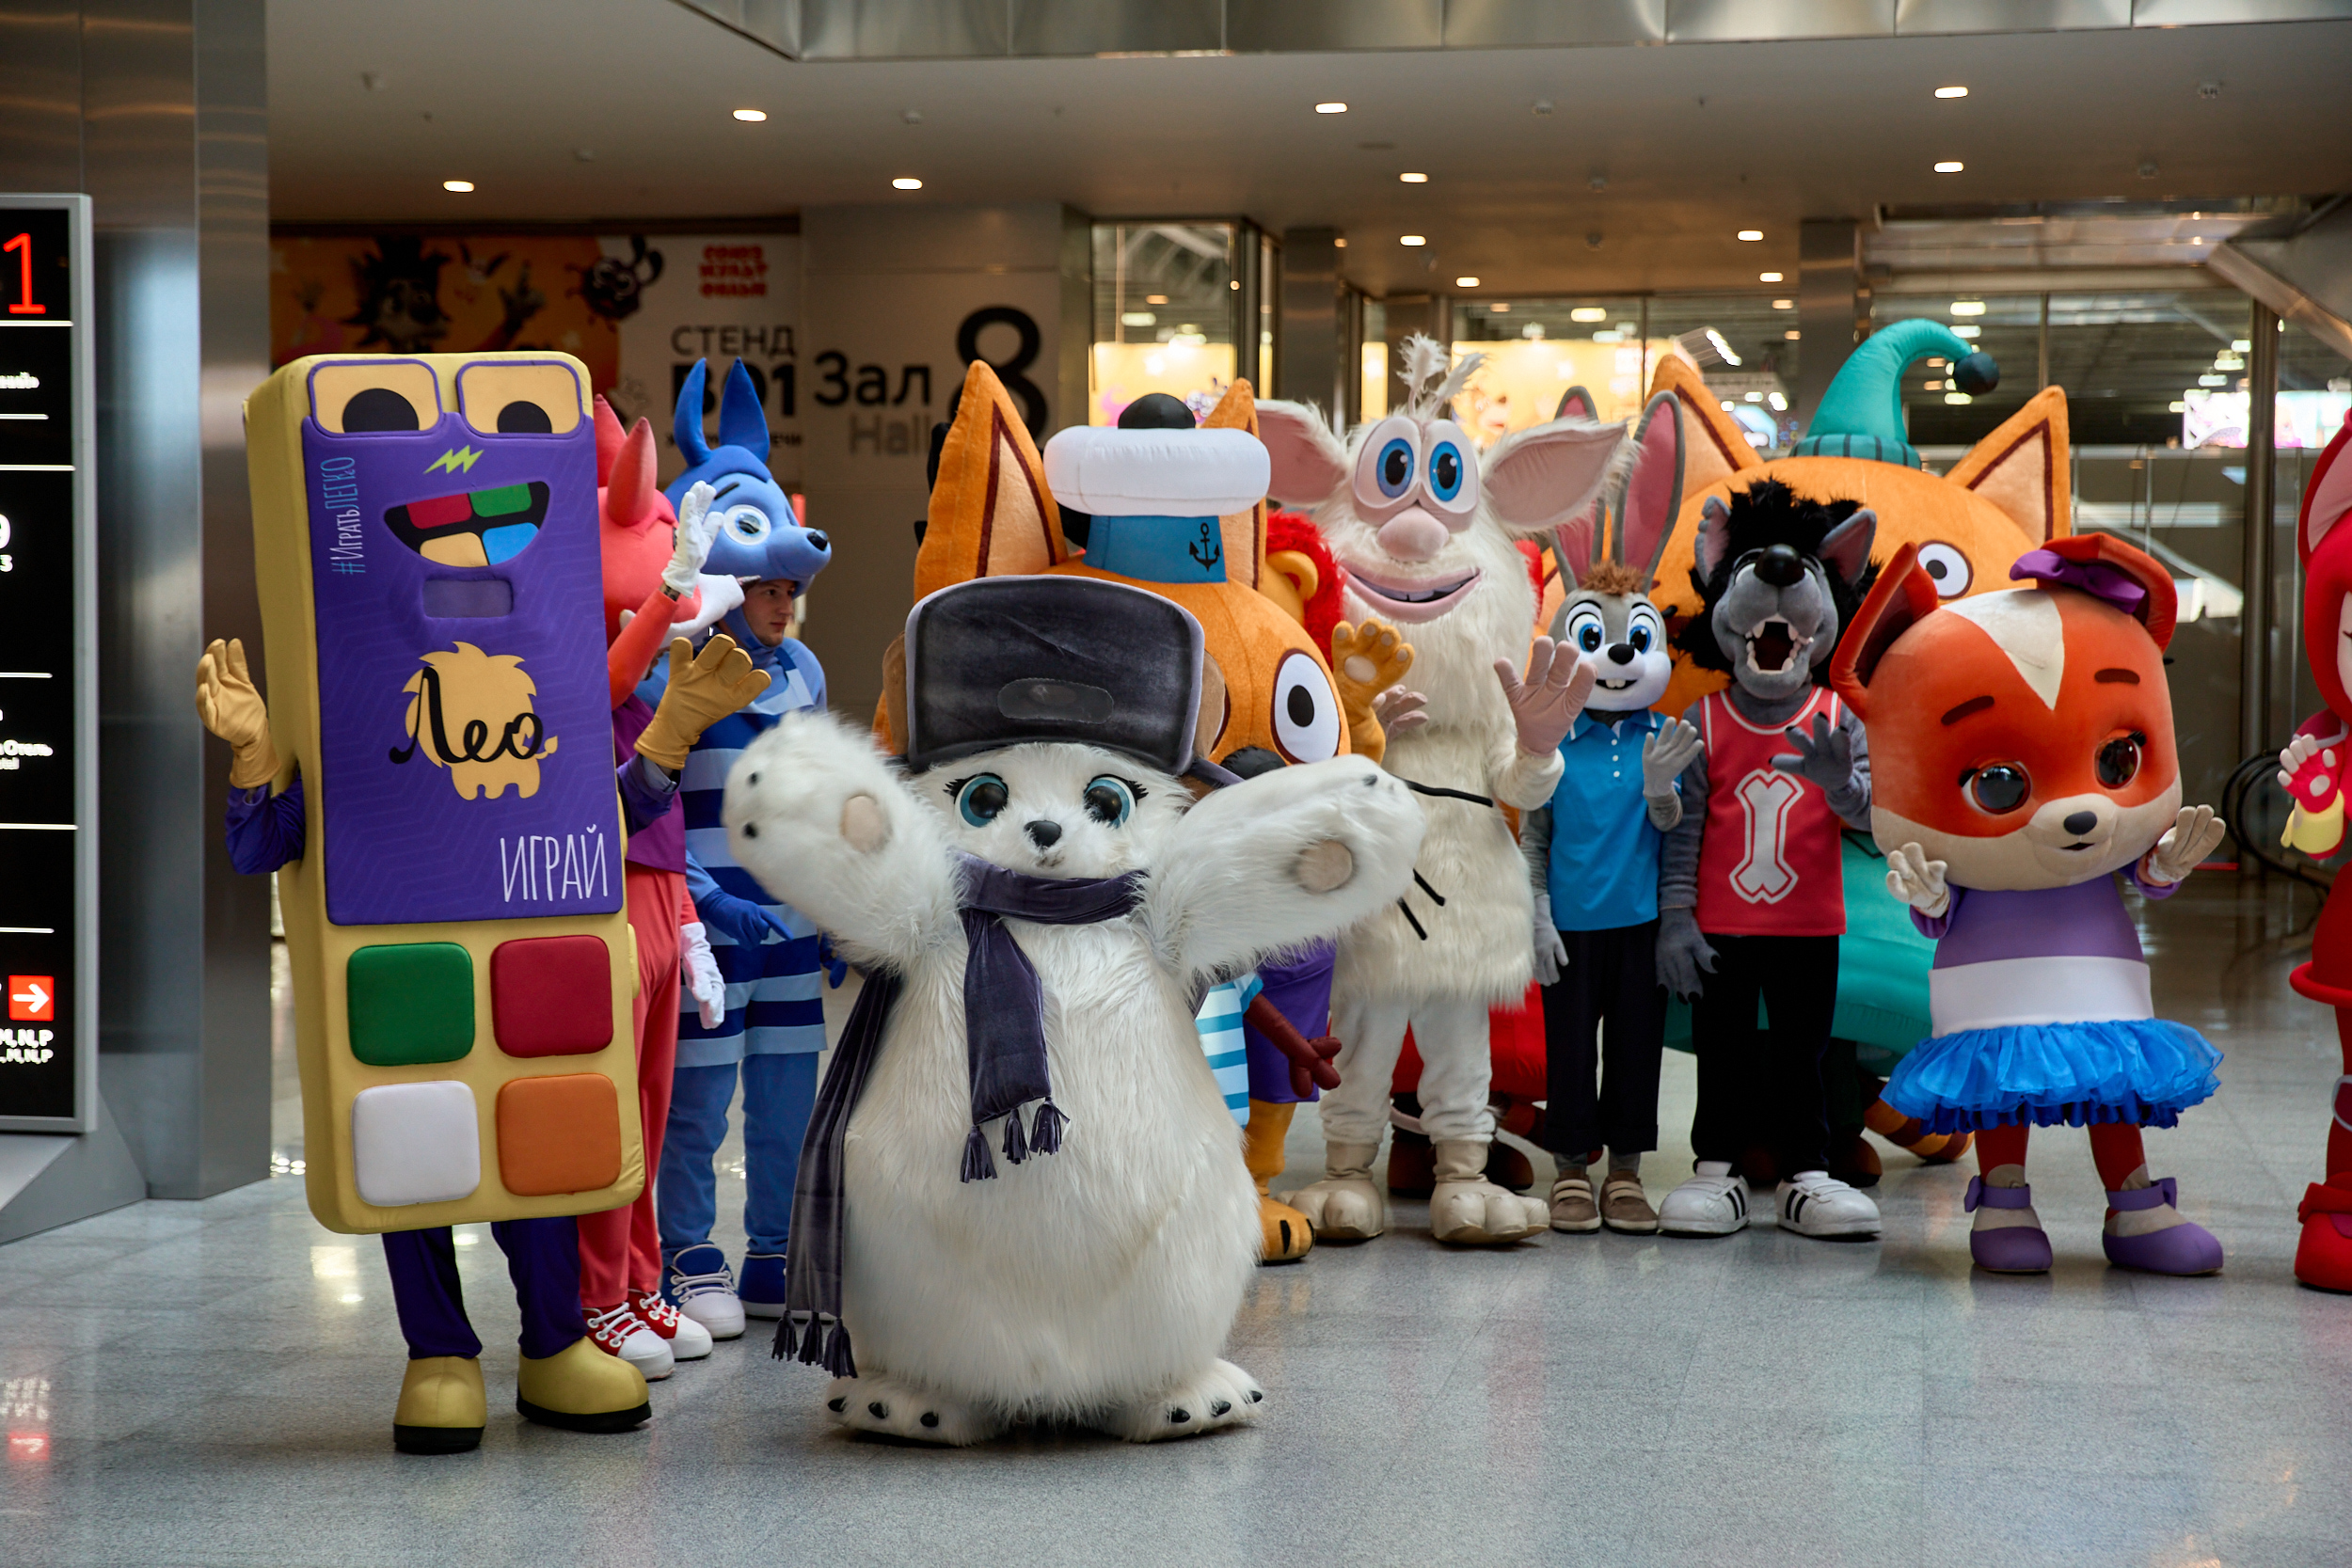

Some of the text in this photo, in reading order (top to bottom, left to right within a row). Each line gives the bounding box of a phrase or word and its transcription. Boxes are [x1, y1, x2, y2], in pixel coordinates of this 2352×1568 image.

[671, 325, 797, 358] СТЕНД
[814, 304, 1048, 446] Зал 8
[389, 666, 544, 764] Лео
[500, 824, 609, 903] ИГРАЙ
